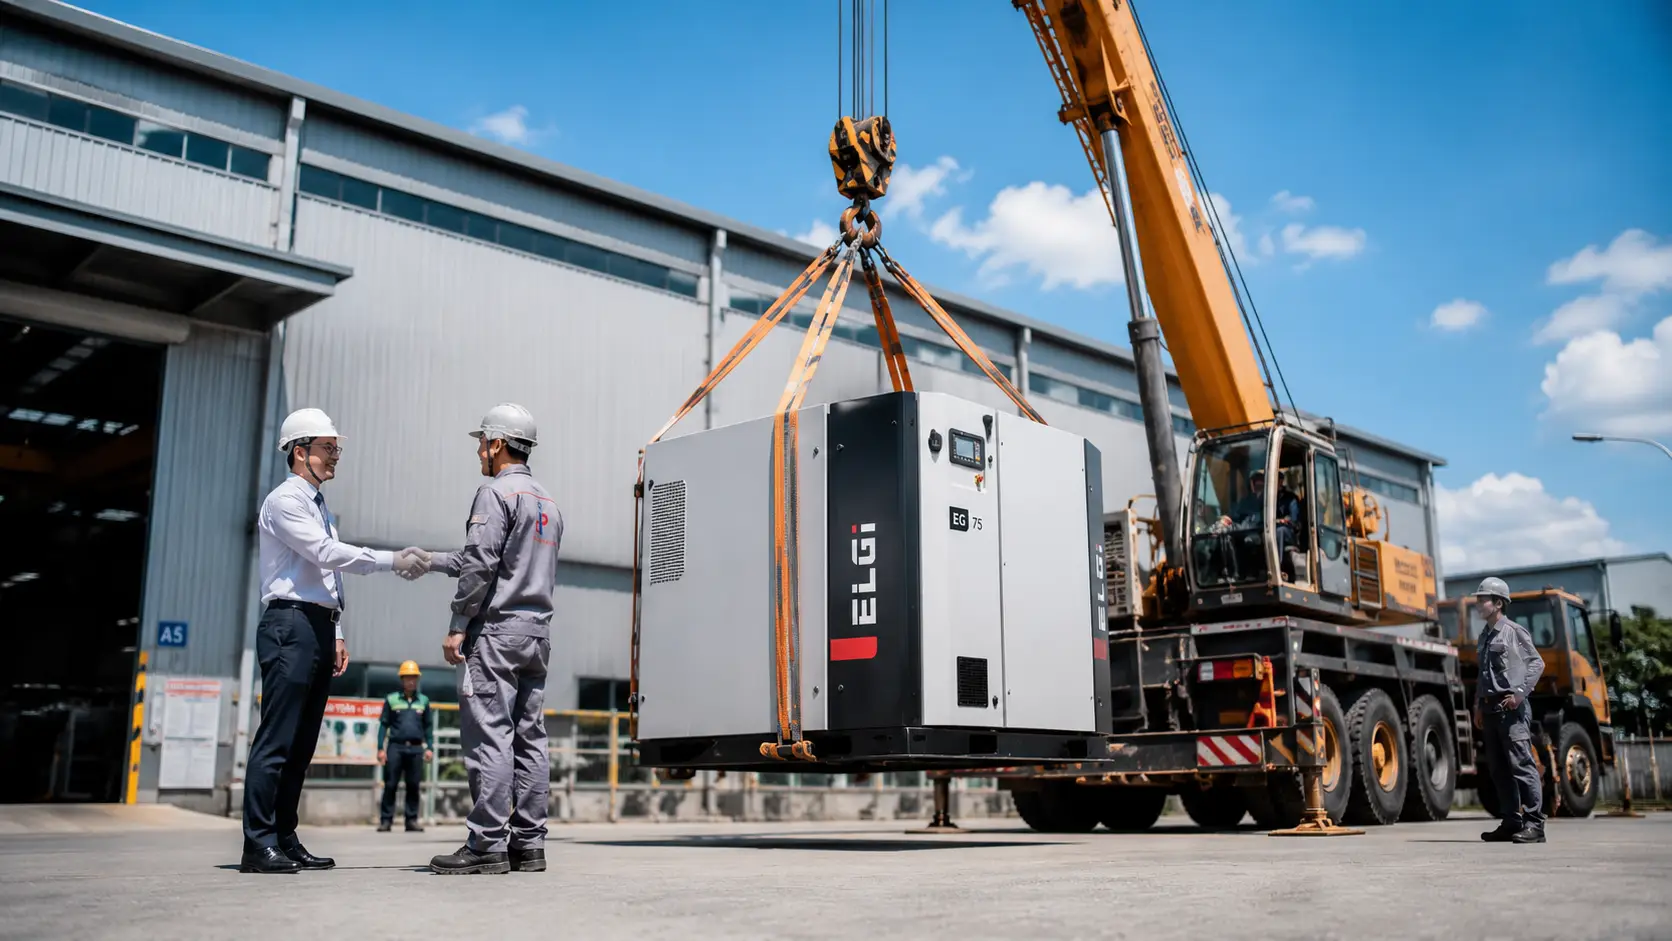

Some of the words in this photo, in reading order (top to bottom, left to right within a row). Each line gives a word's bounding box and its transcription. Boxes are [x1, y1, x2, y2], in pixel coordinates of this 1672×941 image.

[953, 512, 966, 526] EG
[972, 517, 983, 531] 75
[160, 626, 184, 643] A5
